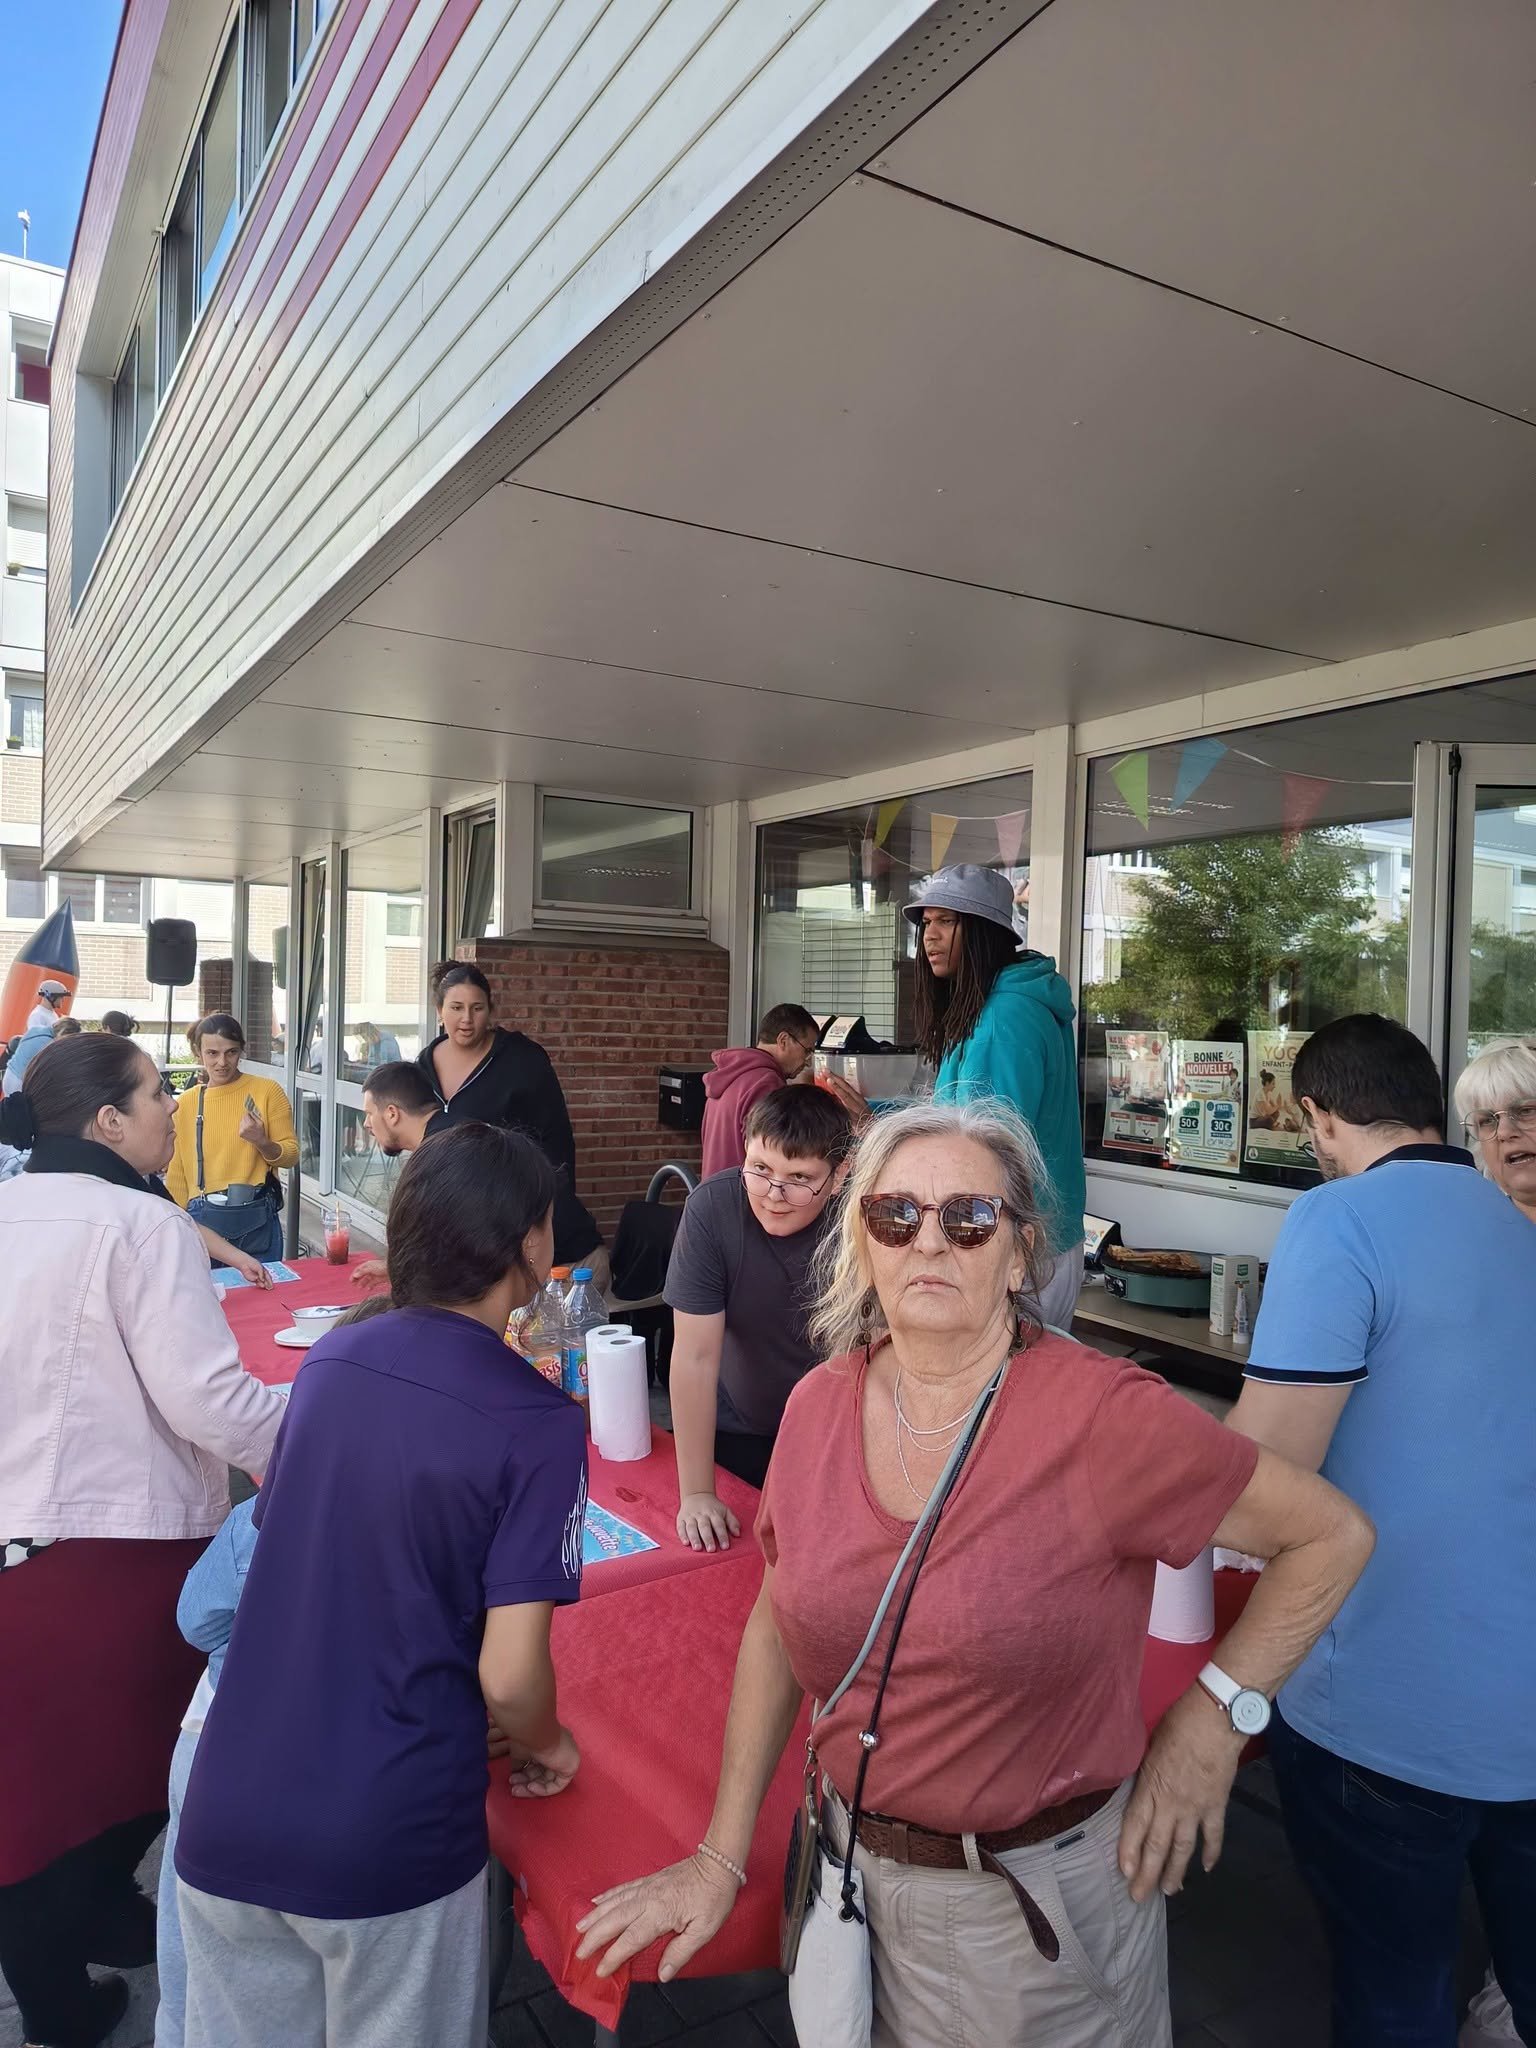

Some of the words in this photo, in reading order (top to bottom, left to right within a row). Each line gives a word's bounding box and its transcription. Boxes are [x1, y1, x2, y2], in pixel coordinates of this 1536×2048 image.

[1194, 1051, 1224, 1063] BONNE
[1263, 1045, 1297, 1061] YOG
[1262, 1060, 1293, 1068] ENFANT-P
[539, 1360, 561, 1377] asis
